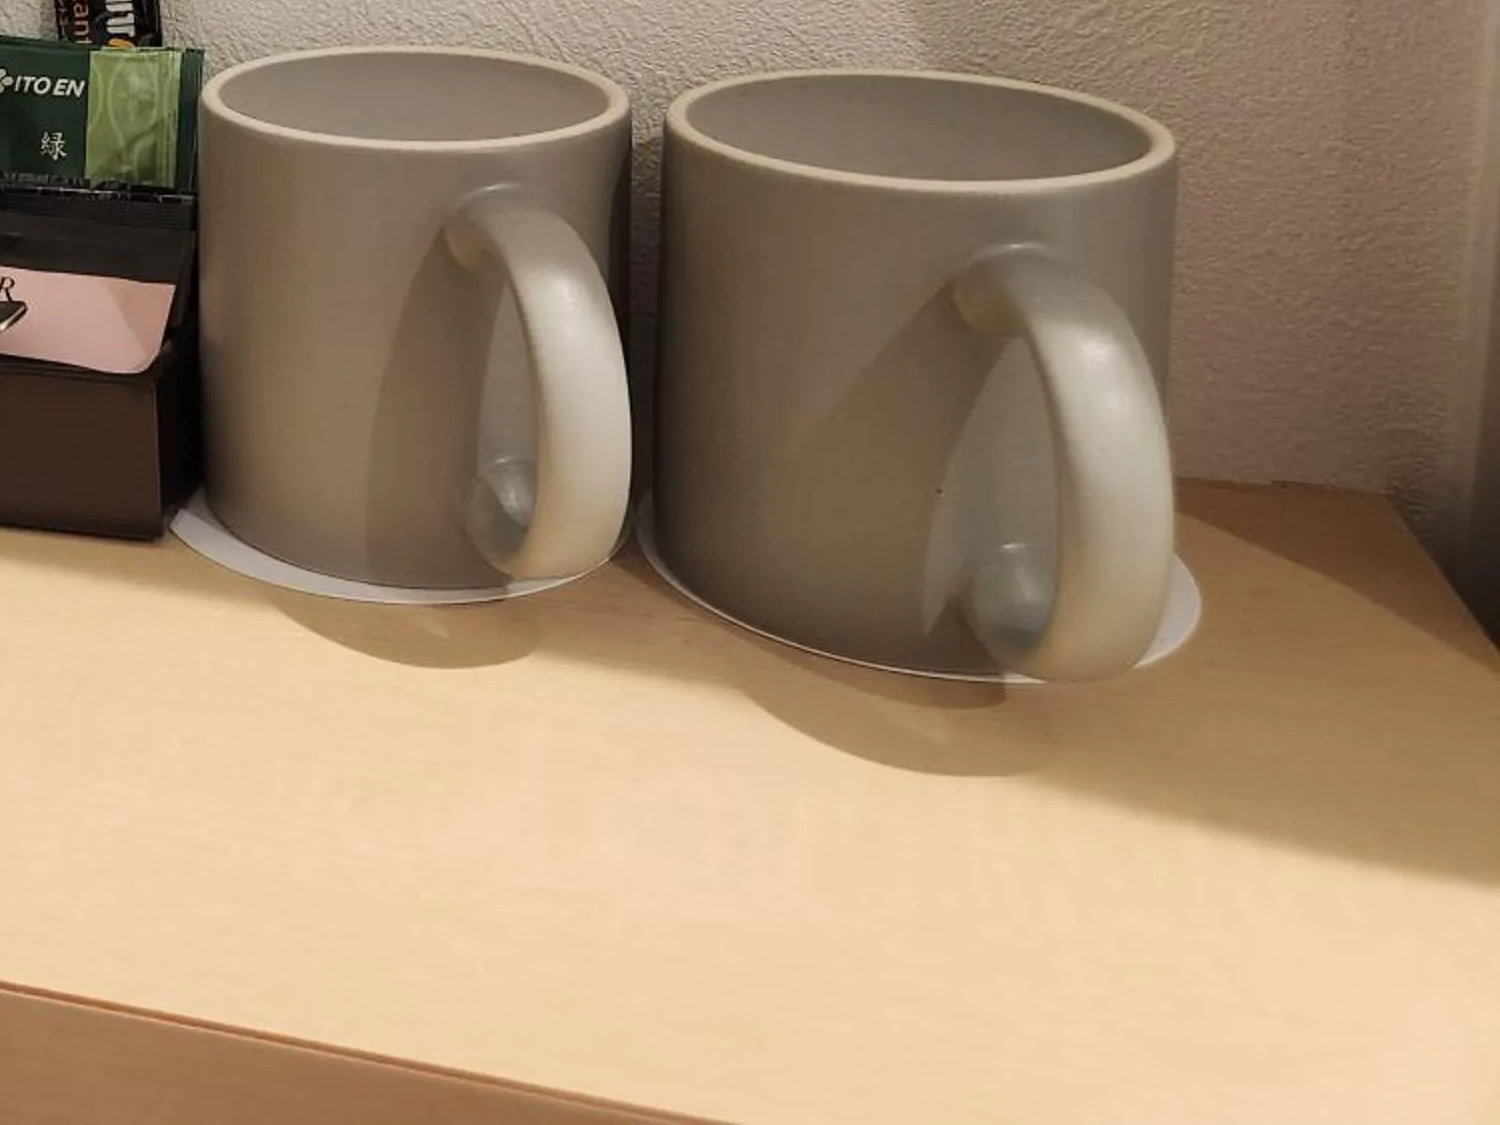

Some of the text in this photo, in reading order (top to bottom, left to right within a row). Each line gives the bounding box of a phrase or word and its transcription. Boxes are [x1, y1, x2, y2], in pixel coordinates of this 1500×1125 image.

[14, 76, 85, 98] ITO EN
[41, 131, 67, 161] 緑
